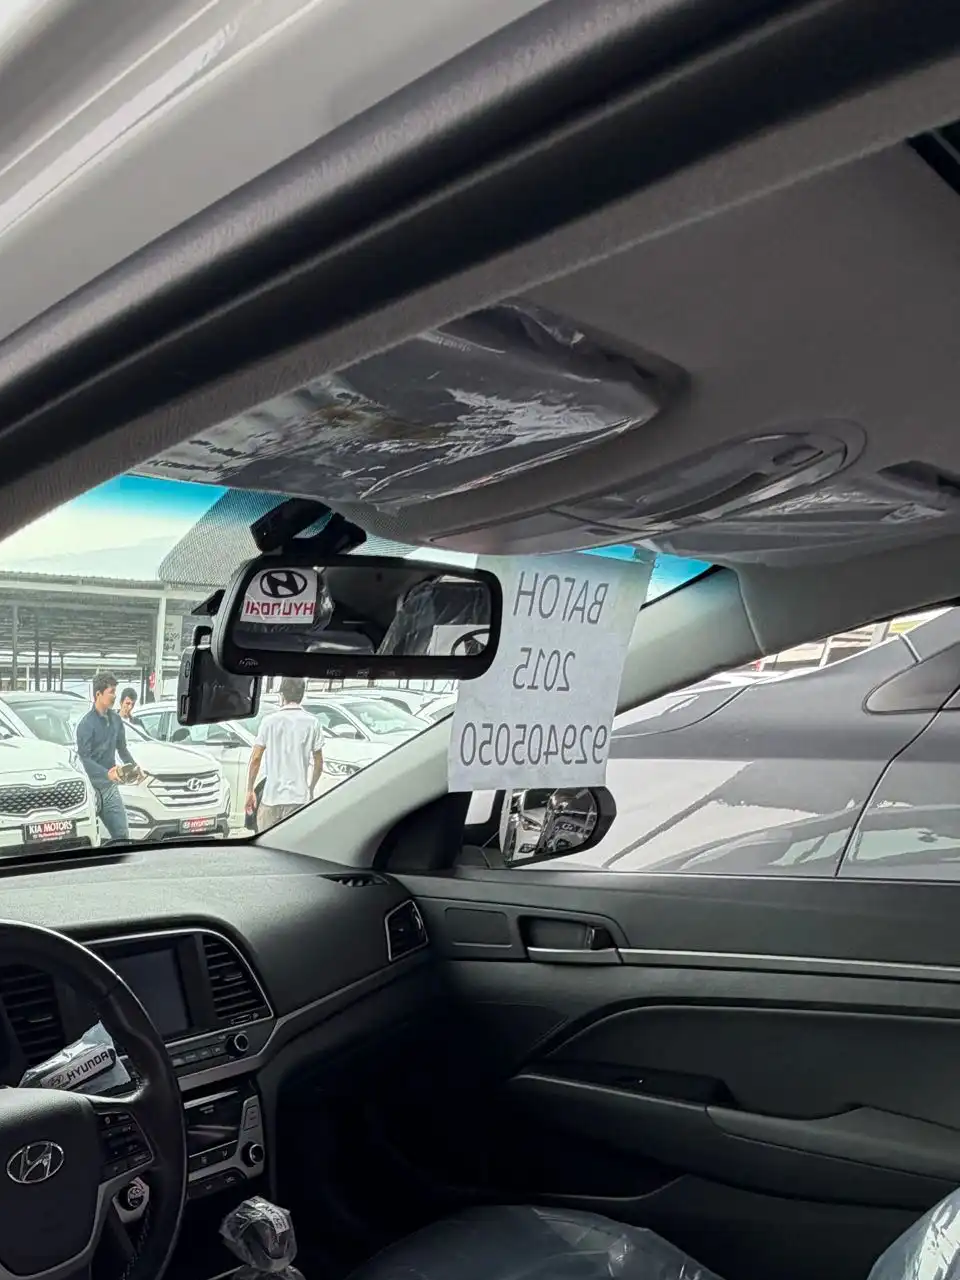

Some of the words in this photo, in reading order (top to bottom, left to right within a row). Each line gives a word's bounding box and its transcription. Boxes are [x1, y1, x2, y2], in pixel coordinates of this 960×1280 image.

[29, 823, 43, 835] KIA
[43, 819, 73, 832] MOTORS
[66, 1050, 109, 1081] HYUNDA
